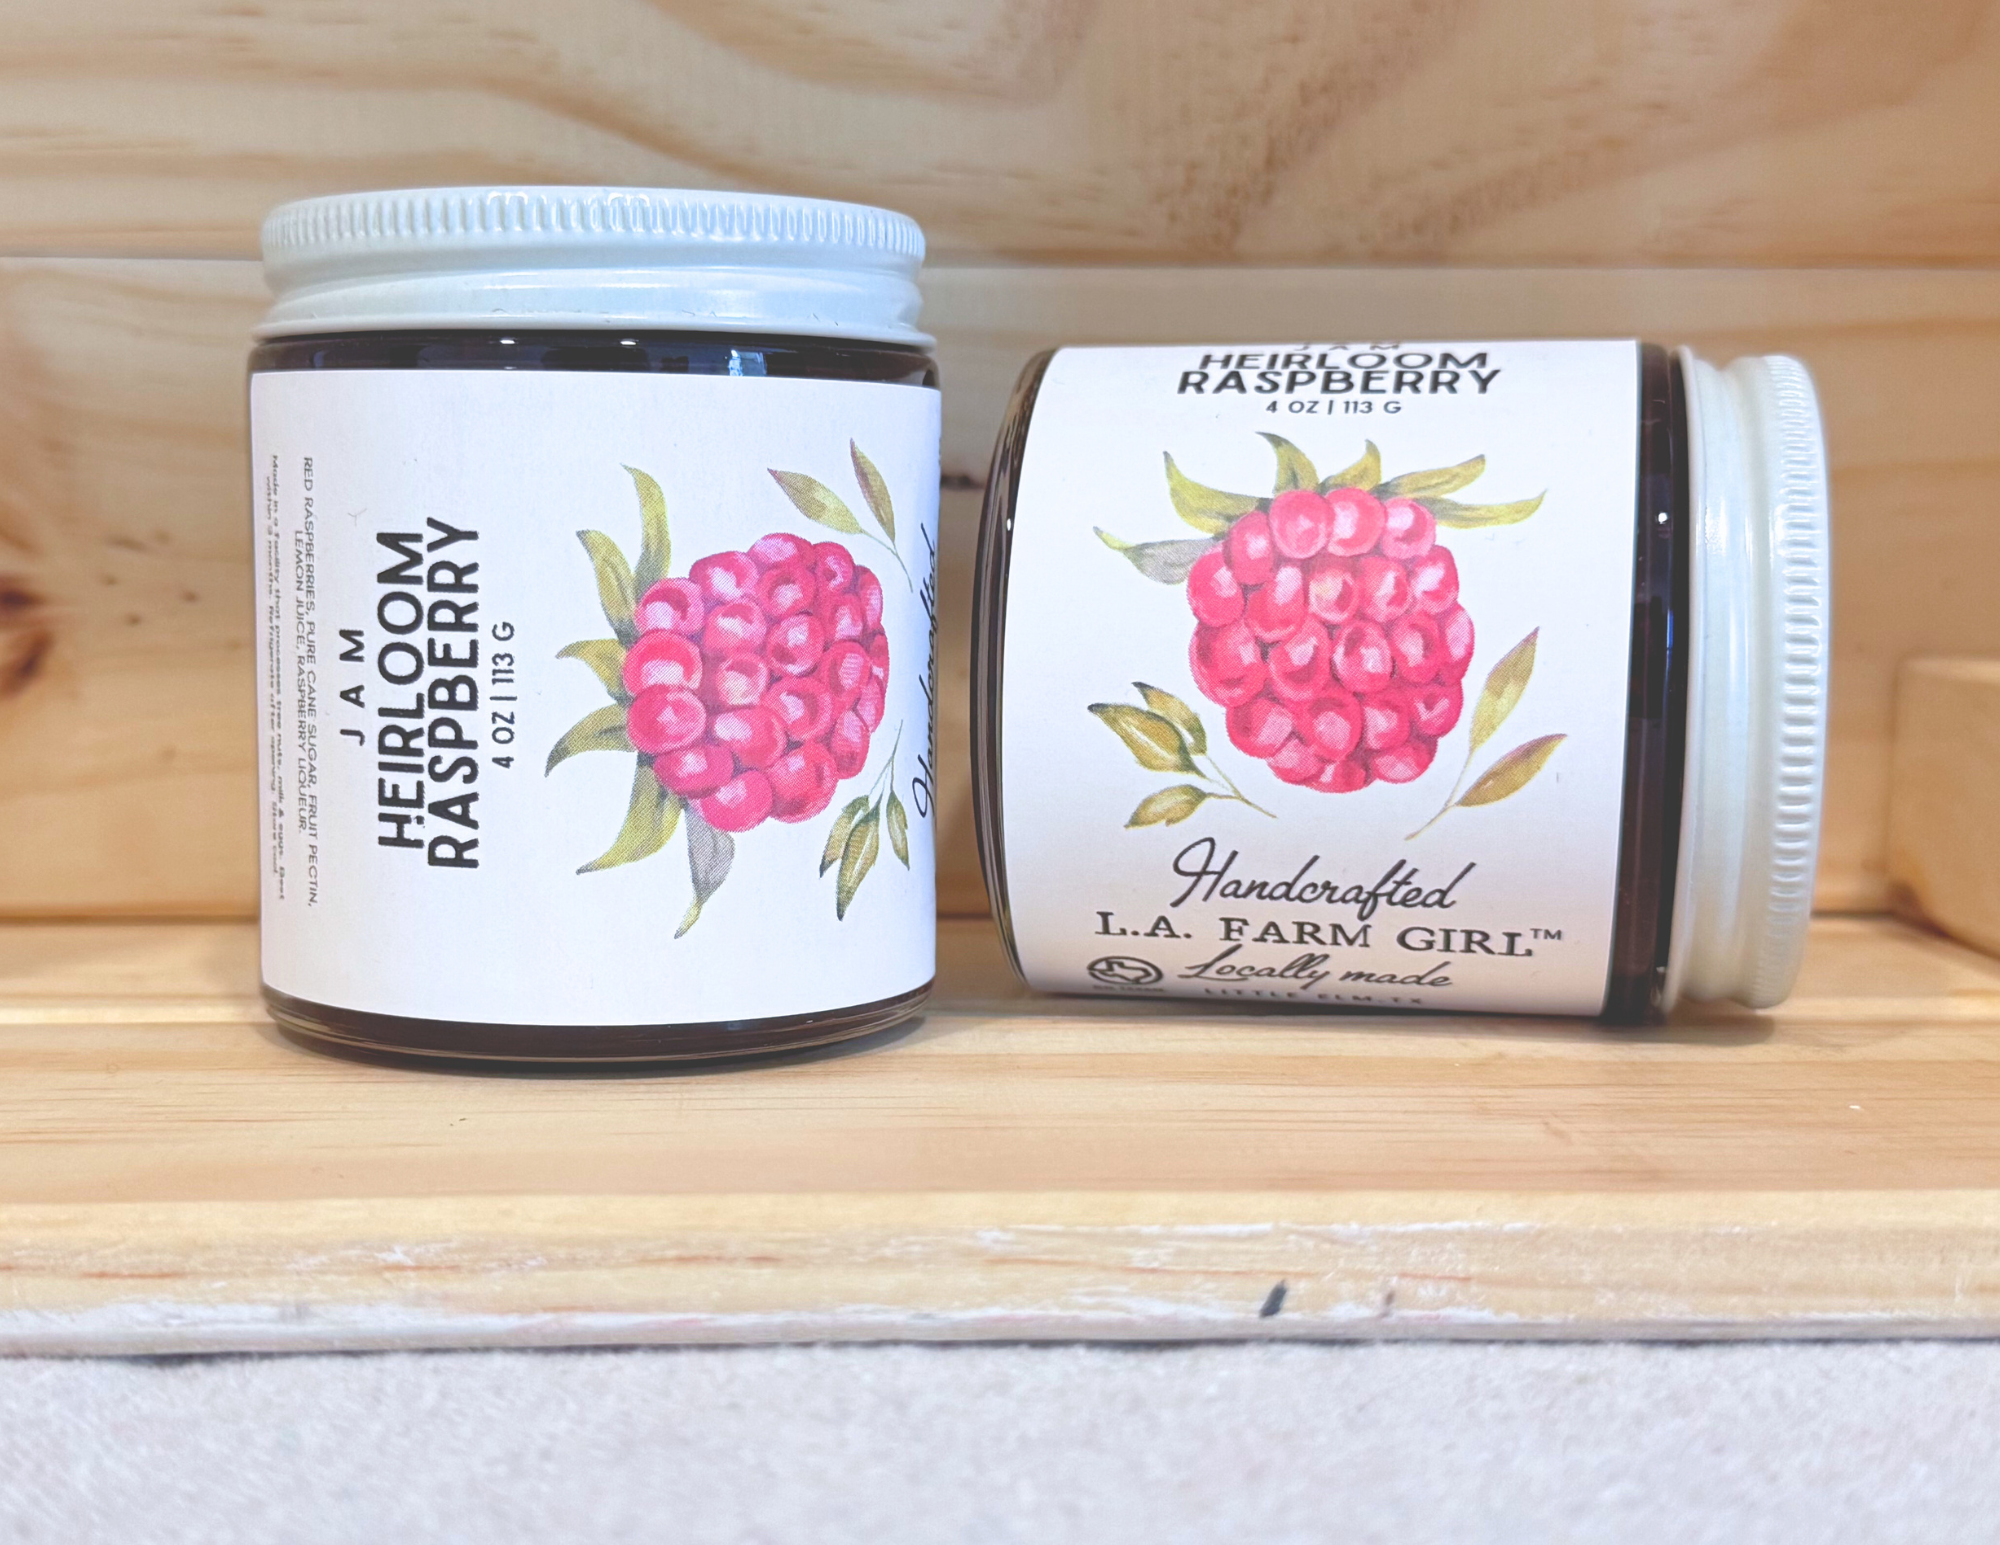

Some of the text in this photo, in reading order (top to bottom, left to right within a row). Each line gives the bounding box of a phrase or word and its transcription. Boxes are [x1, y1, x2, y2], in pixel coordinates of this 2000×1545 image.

[1199, 352, 1488, 370] HEIRLOOM
[1177, 369, 1502, 395] RASPBERRY
[1265, 400, 1278, 414] 4
[1287, 400, 1319, 414] OZ
[1343, 400, 1373, 414] 113
[1382, 400, 1402, 414] G
[272, 454, 280, 497] Made
[491, 621, 516, 642] G
[294, 530, 308, 834] LEMON JUICE, RASPBERRY LIQUEUR.
[303, 457, 319, 907] RED RASPBERRIES, PURE CANE SUGAR, FRUIT PECTIN,
[491, 652, 516, 686] 113
[376, 532, 426, 849] HEIRLOOM
[426, 516, 480, 869] RASPBERRY
[491, 711, 516, 745] OZ
[491, 756, 515, 769] 4
[1170, 837, 1476, 921] Handcrafted
[1094, 911, 1193, 940] L.A.
[1219, 917, 1372, 948] FARM
[1177, 944, 1454, 990] Locally made
